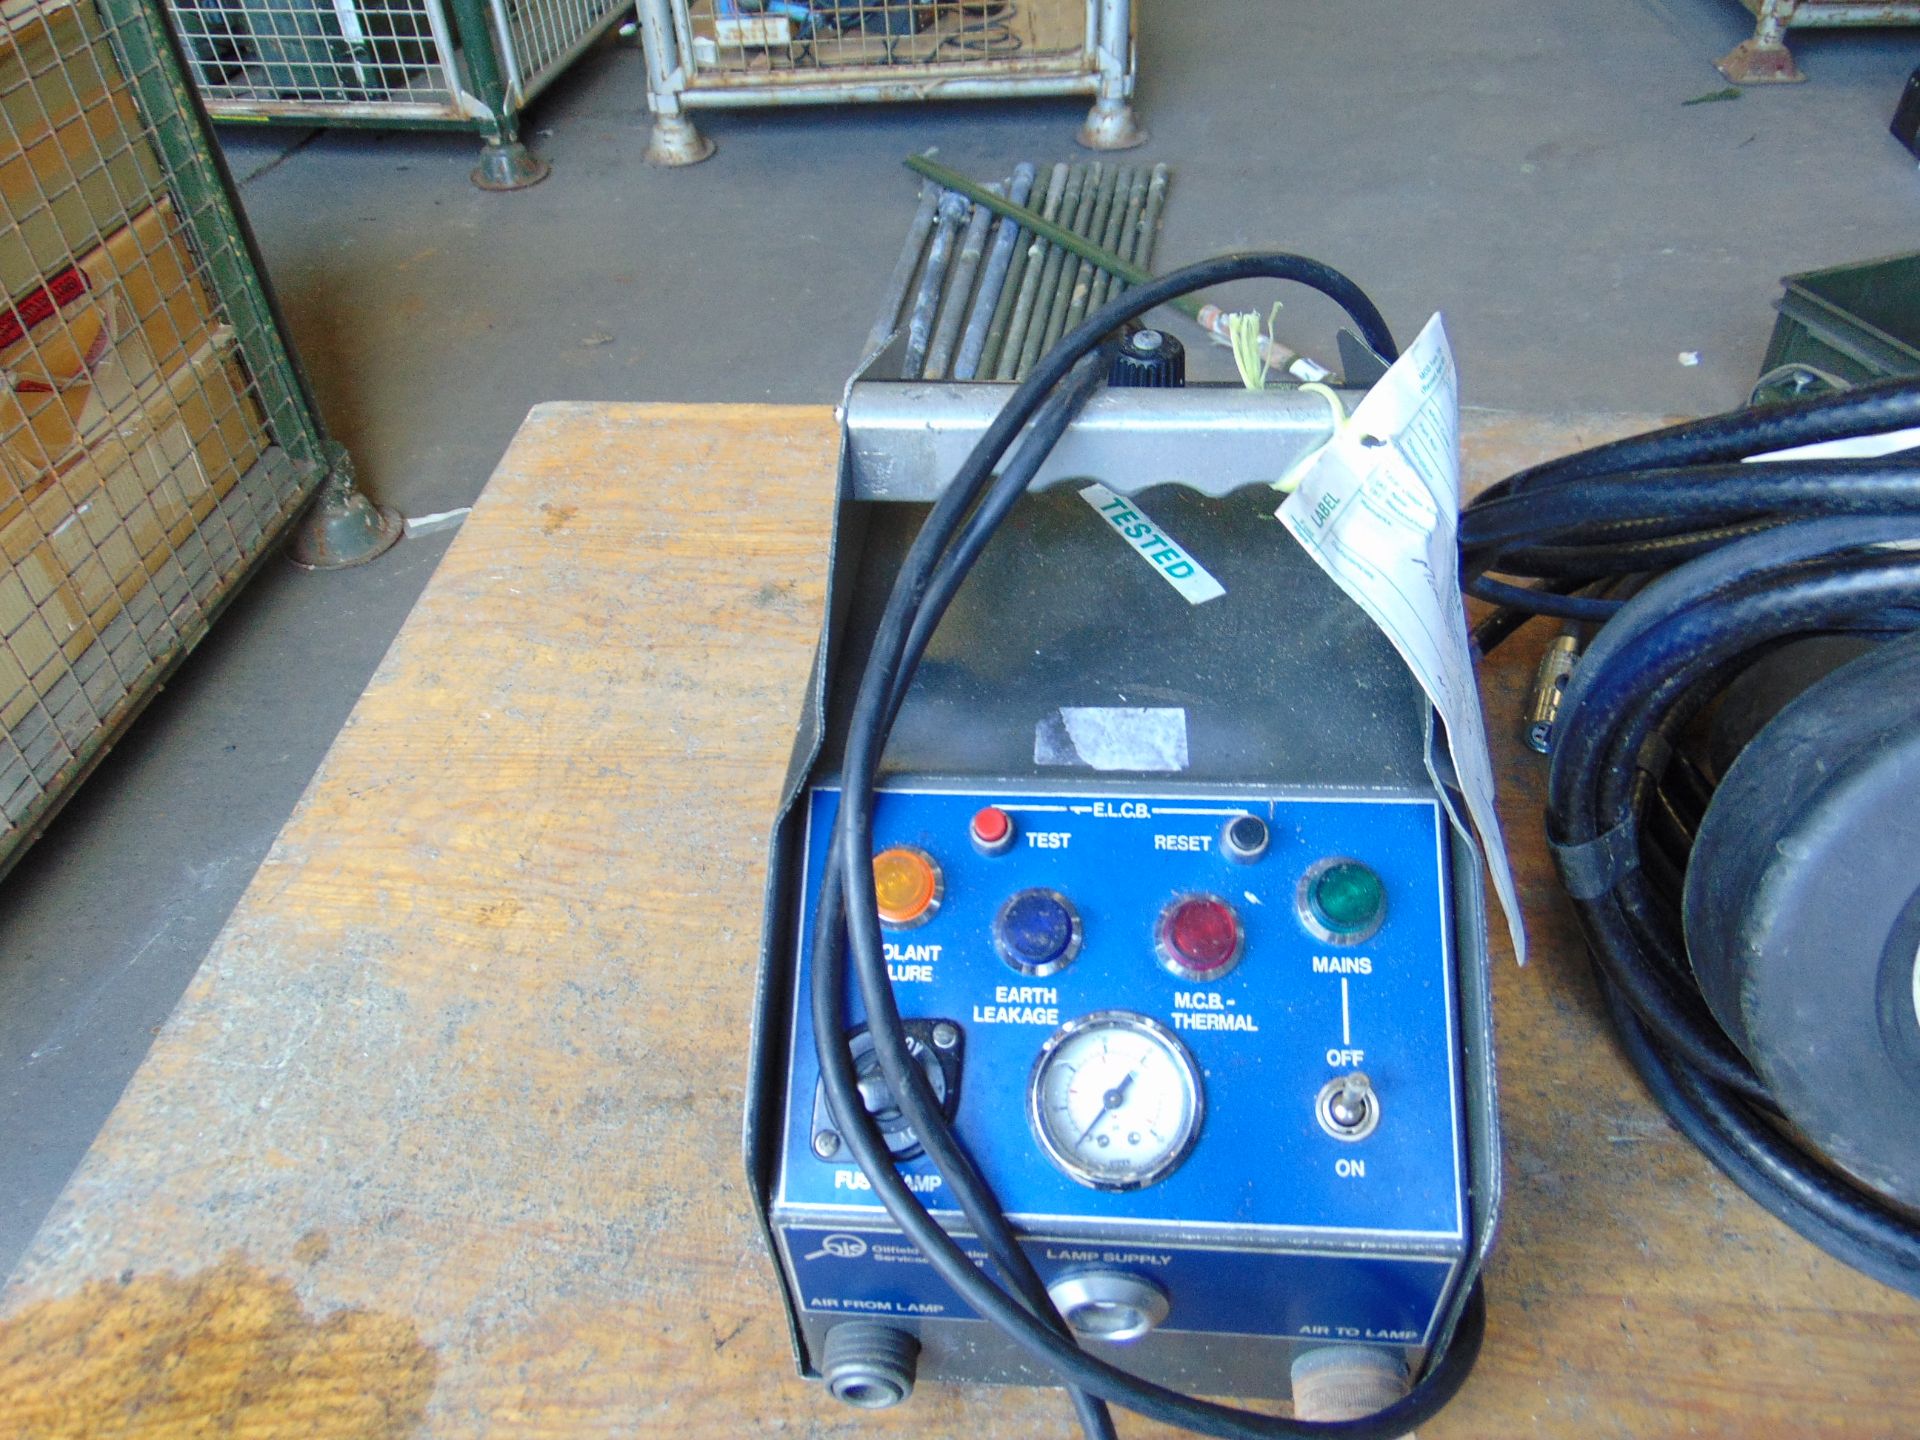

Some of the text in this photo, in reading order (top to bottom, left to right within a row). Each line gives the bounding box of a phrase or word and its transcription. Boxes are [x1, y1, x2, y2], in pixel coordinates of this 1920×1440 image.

[1310, 491, 1341, 529] LABEL
[1100, 496, 1195, 580] TESTED
[1093, 801, 1151, 819] E.L.C.B.
[1025, 831, 1072, 849] TEST
[1153, 834, 1212, 852] RESET
[882, 943, 942, 961] OLANT
[887, 964, 933, 982] LURE
[1312, 956, 1372, 974] MAINS
[995, 985, 1057, 1004] EARTH
[973, 1005, 1059, 1025] LEAKAGE
[1170, 1012, 1259, 1031] THERMAL
[1326, 1049, 1364, 1067] OFF
[1335, 1159, 1365, 1177] ON
[834, 1170, 872, 1190] FUS
[1046, 1248, 1172, 1266] LAMP SUPPLY
[810, 1297, 945, 1313] AIR FROM LAMP
[1299, 1324, 1418, 1340] AIR TO LAMP
